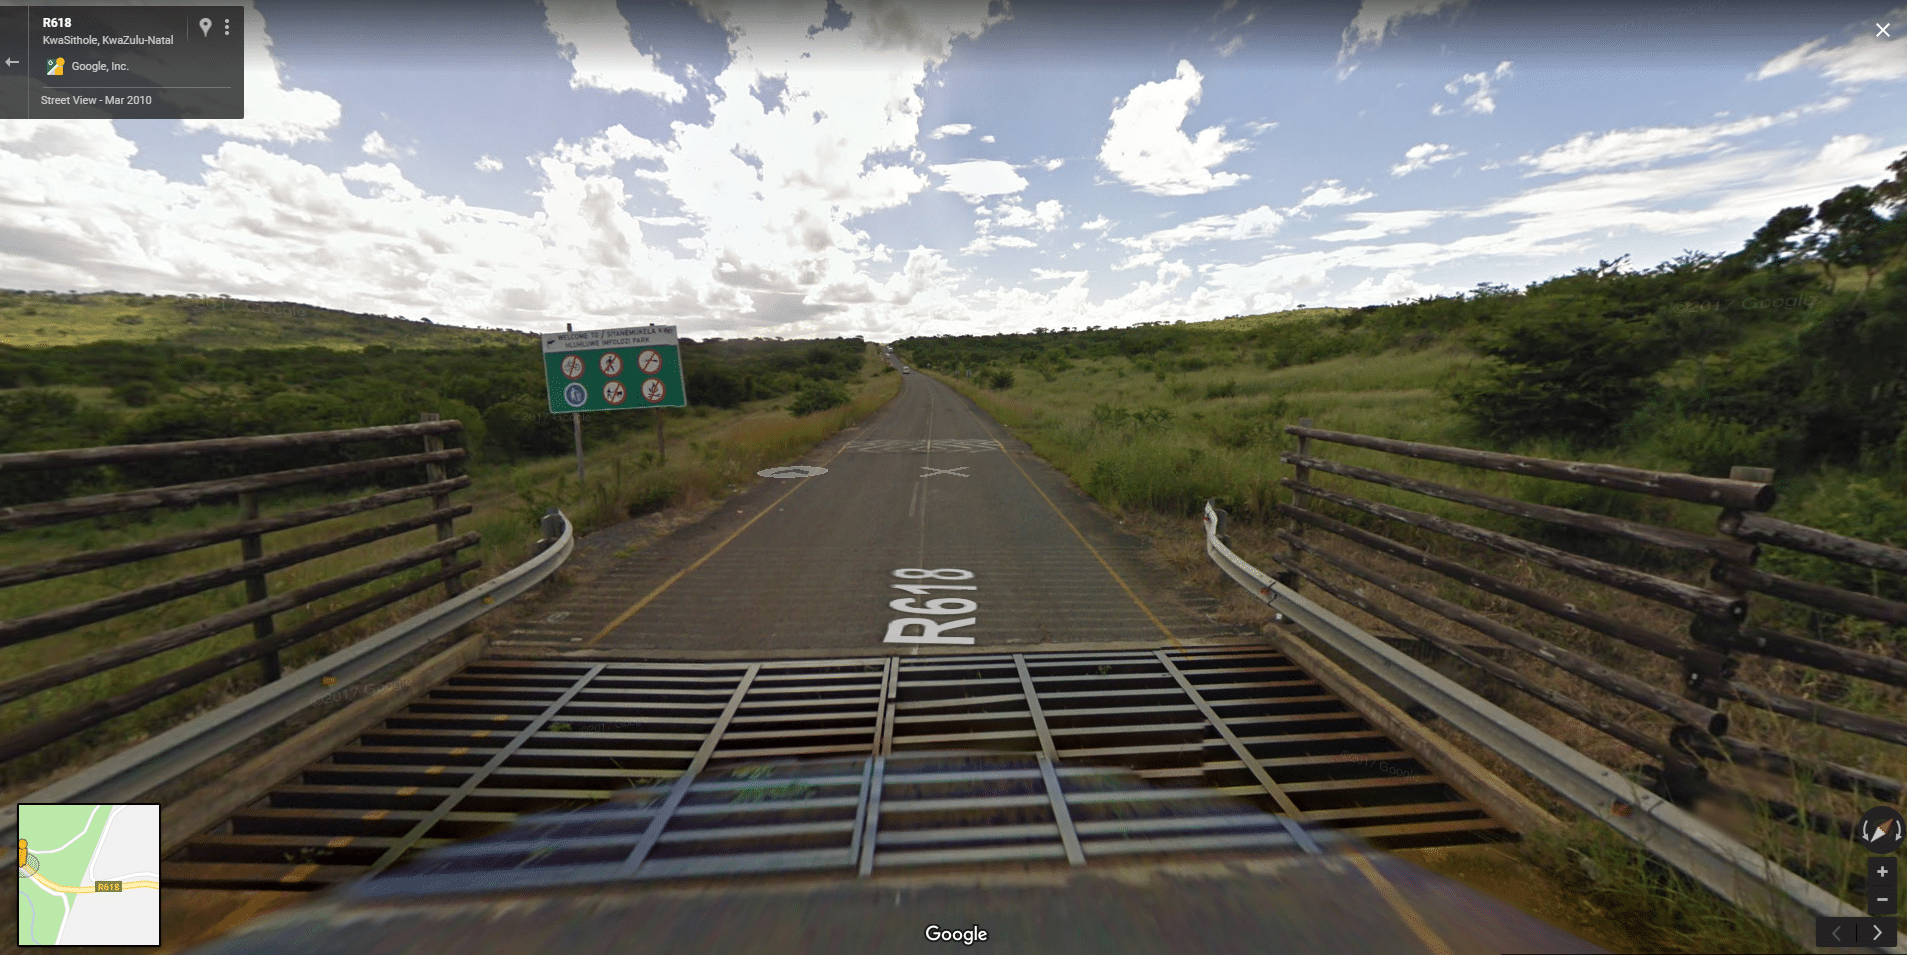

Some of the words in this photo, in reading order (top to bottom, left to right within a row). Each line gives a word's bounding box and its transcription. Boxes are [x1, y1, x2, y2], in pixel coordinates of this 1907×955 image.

[558, 332, 589, 341] WELCOME
[591, 331, 599, 339] TO
[565, 340, 600, 349] HLUHLUWE
[602, 337, 631, 346] IMFOLOZI
[632, 336, 650, 344] PARK
